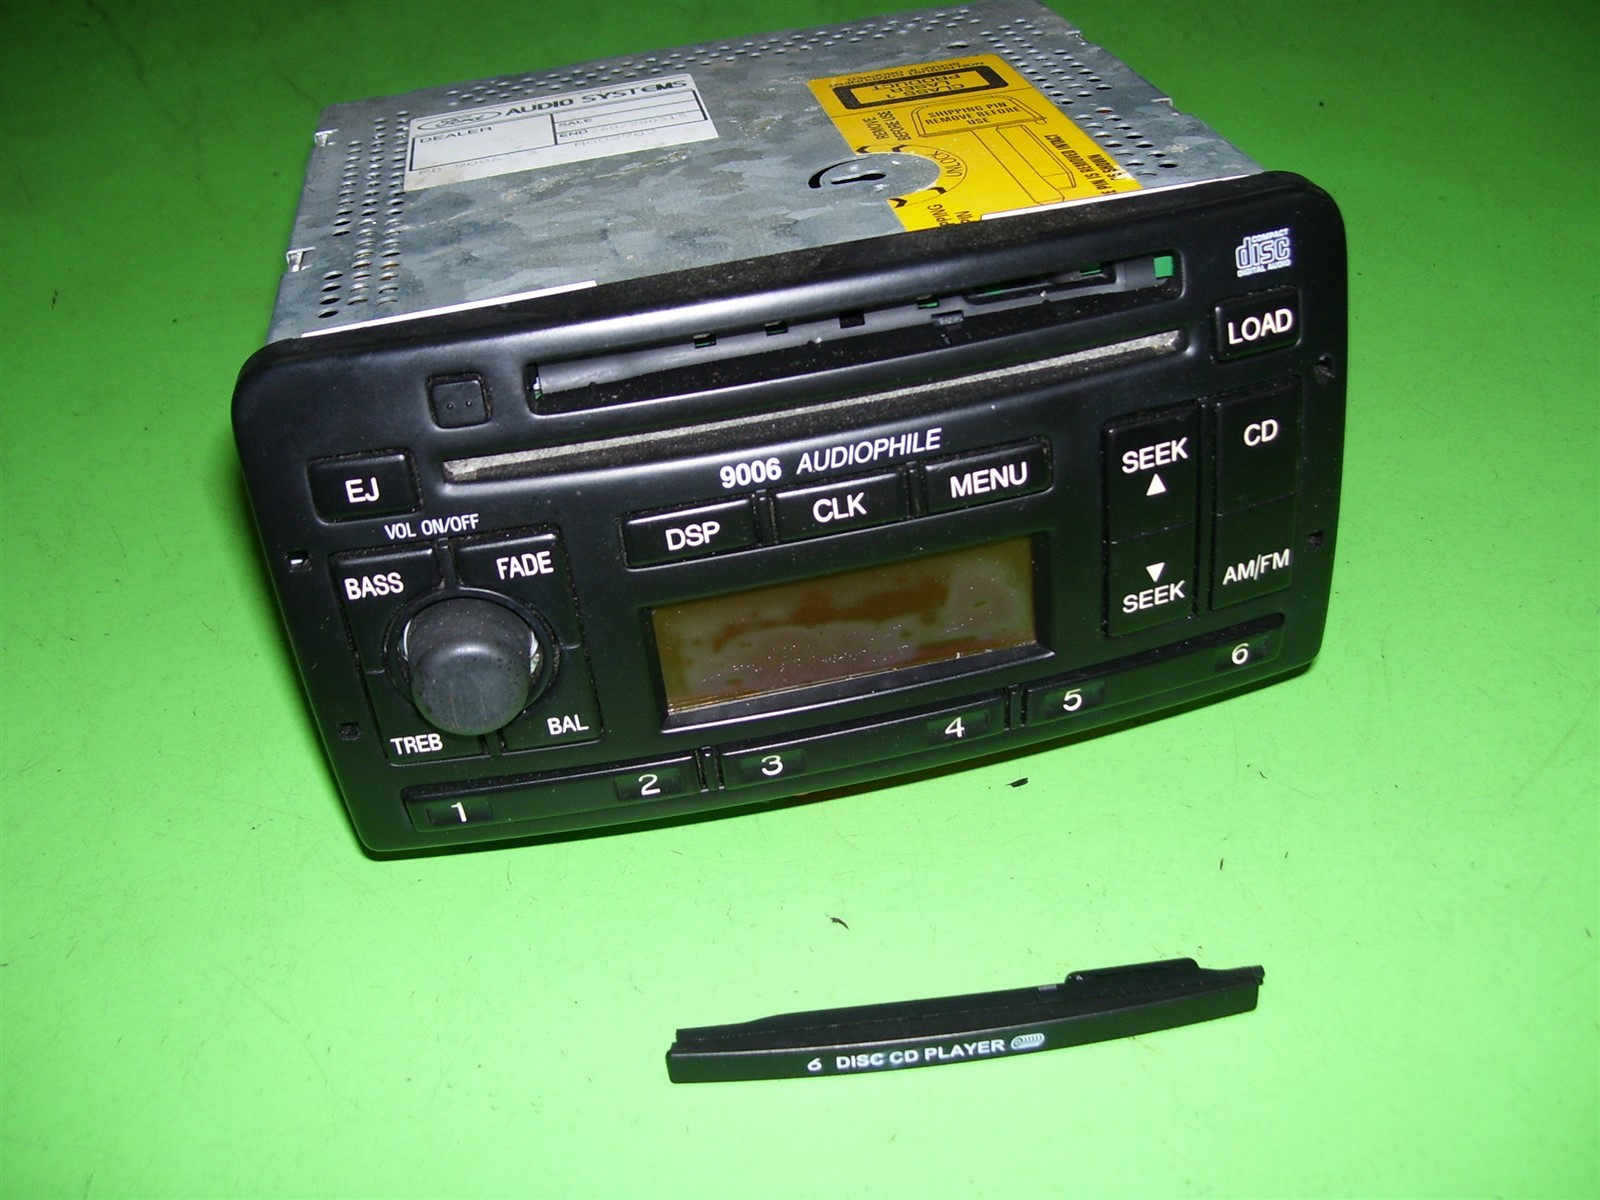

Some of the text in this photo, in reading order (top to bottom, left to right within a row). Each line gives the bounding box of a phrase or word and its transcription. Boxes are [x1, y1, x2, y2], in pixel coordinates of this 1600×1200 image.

[873, 73, 960, 91] PRODUCT
[890, 80, 950, 94] LASER
[902, 83, 965, 97] CLASS
[505, 98, 575, 116] AUDIO
[582, 79, 688, 103] SYSTEMS
[927, 101, 1008, 118] SHIPPING PIN
[862, 116, 890, 139] REMOVE
[877, 110, 912, 141] BEFORE USE
[925, 106, 1021, 125] REMOVE BEFORE
[966, 117, 990, 126] USE
[420, 126, 493, 143] DEALER
[925, 150, 963, 178] UNLOCK
[1044, 134, 1112, 190] PIN IS REMOVED INTACT
[1087, 153, 1117, 173] SHOWN
[1234, 236, 1291, 270] disc
[1228, 308, 1293, 345] LOAD
[1243, 418, 1279, 447] CD
[719, 428, 943, 488] 9006 AUDIOPHILE
[1121, 437, 1189, 474] SEEK
[345, 477, 381, 503] EJ
[949, 461, 1029, 499] MENU
[812, 492, 868, 524] CLK
[384, 513, 480, 540] VOL ON/OFF
[665, 521, 721, 552] DSP
[496, 551, 554, 580] FADE
[1222, 548, 1291, 586] AM/FM
[344, 572, 404, 601] BASS
[1122, 580, 1186, 613] SEEK
[1231, 643, 1250, 665] 6
[1062, 688, 1084, 712] 5
[547, 714, 590, 736] BAL
[945, 717, 966, 738] 4
[390, 733, 443, 757] TREB
[760, 754, 785, 777] 3
[637, 774, 662, 797] 2
[450, 801, 469, 824] 1
[806, 1038, 1006, 1072] 6 DISC CD PLAYER
